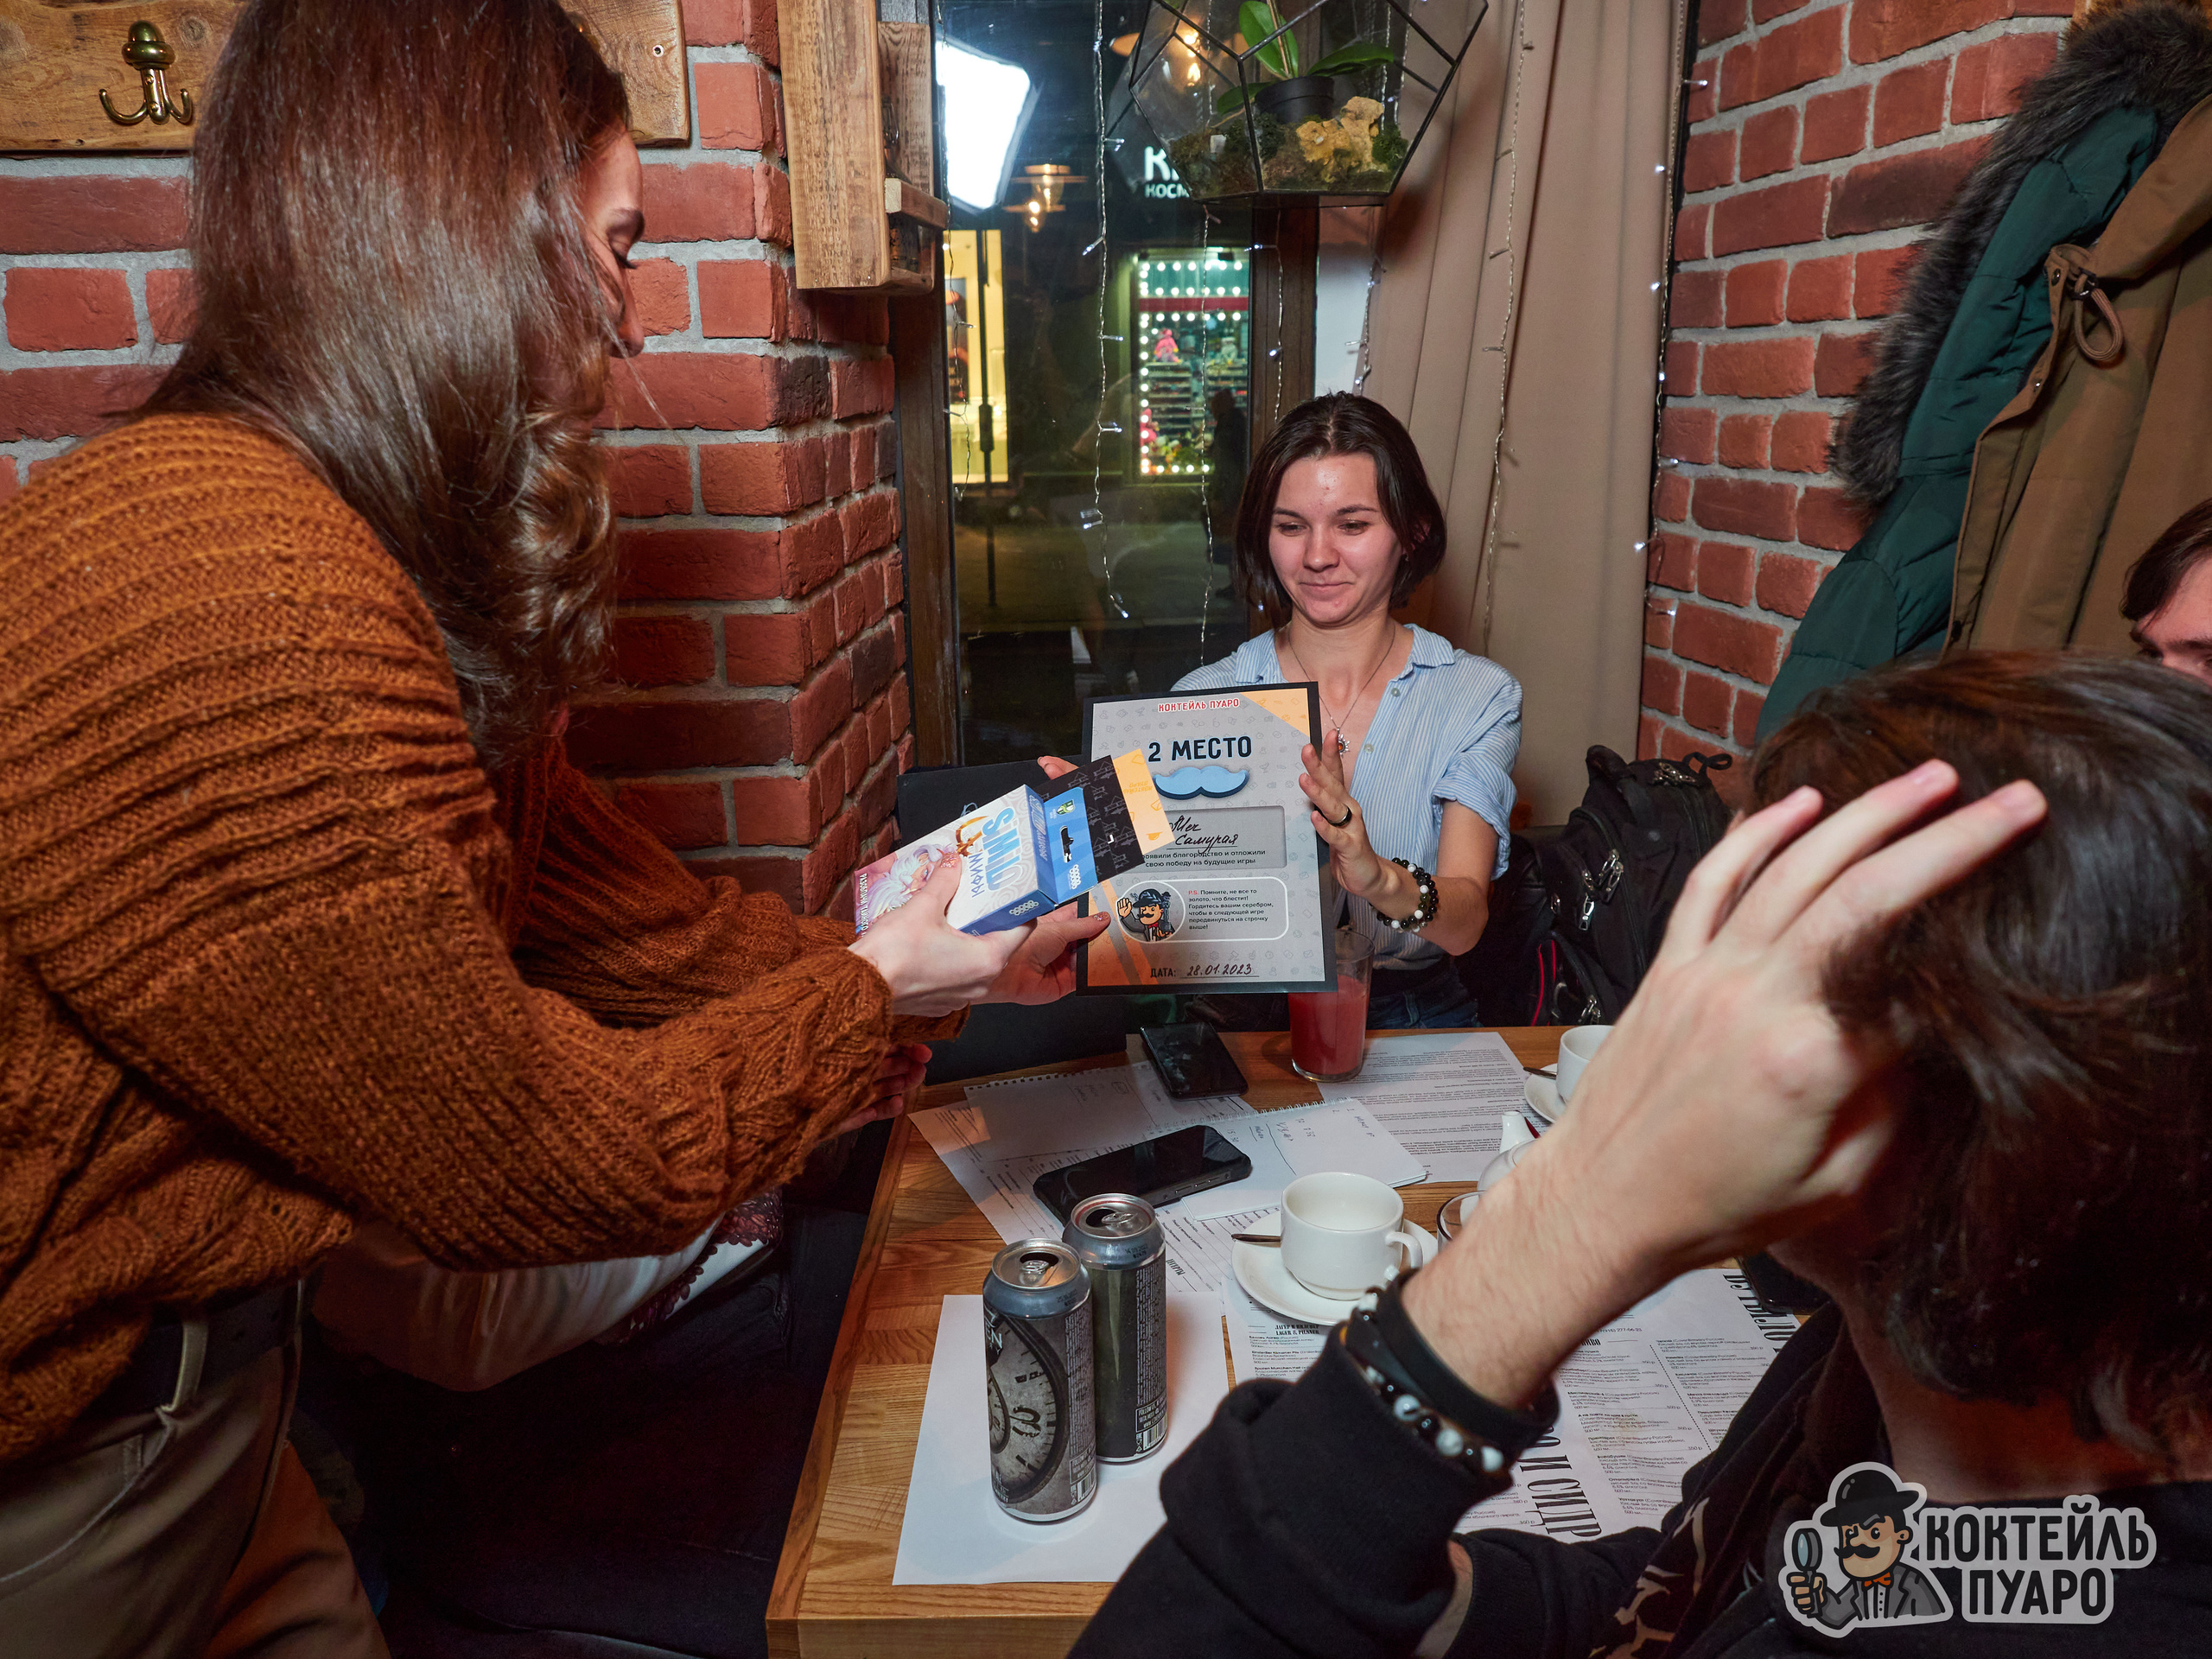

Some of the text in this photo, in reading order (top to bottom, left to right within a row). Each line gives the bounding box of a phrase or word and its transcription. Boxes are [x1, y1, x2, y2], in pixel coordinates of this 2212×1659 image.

[1144, 145, 1179, 181] К
[1144, 183, 1190, 199] КОСМ
[1158, 698, 1240, 712] КОКТЕЙЛЬ ПУАРО
[1147, 735, 1252, 762] 2 МЕСТО
[982, 807, 1023, 892] SIMILO
[1166, 859, 1192, 868] победу
[968, 852, 986, 898] МИФЫ
[1150, 963, 1252, 978] ДАТА: 28.01.2023
